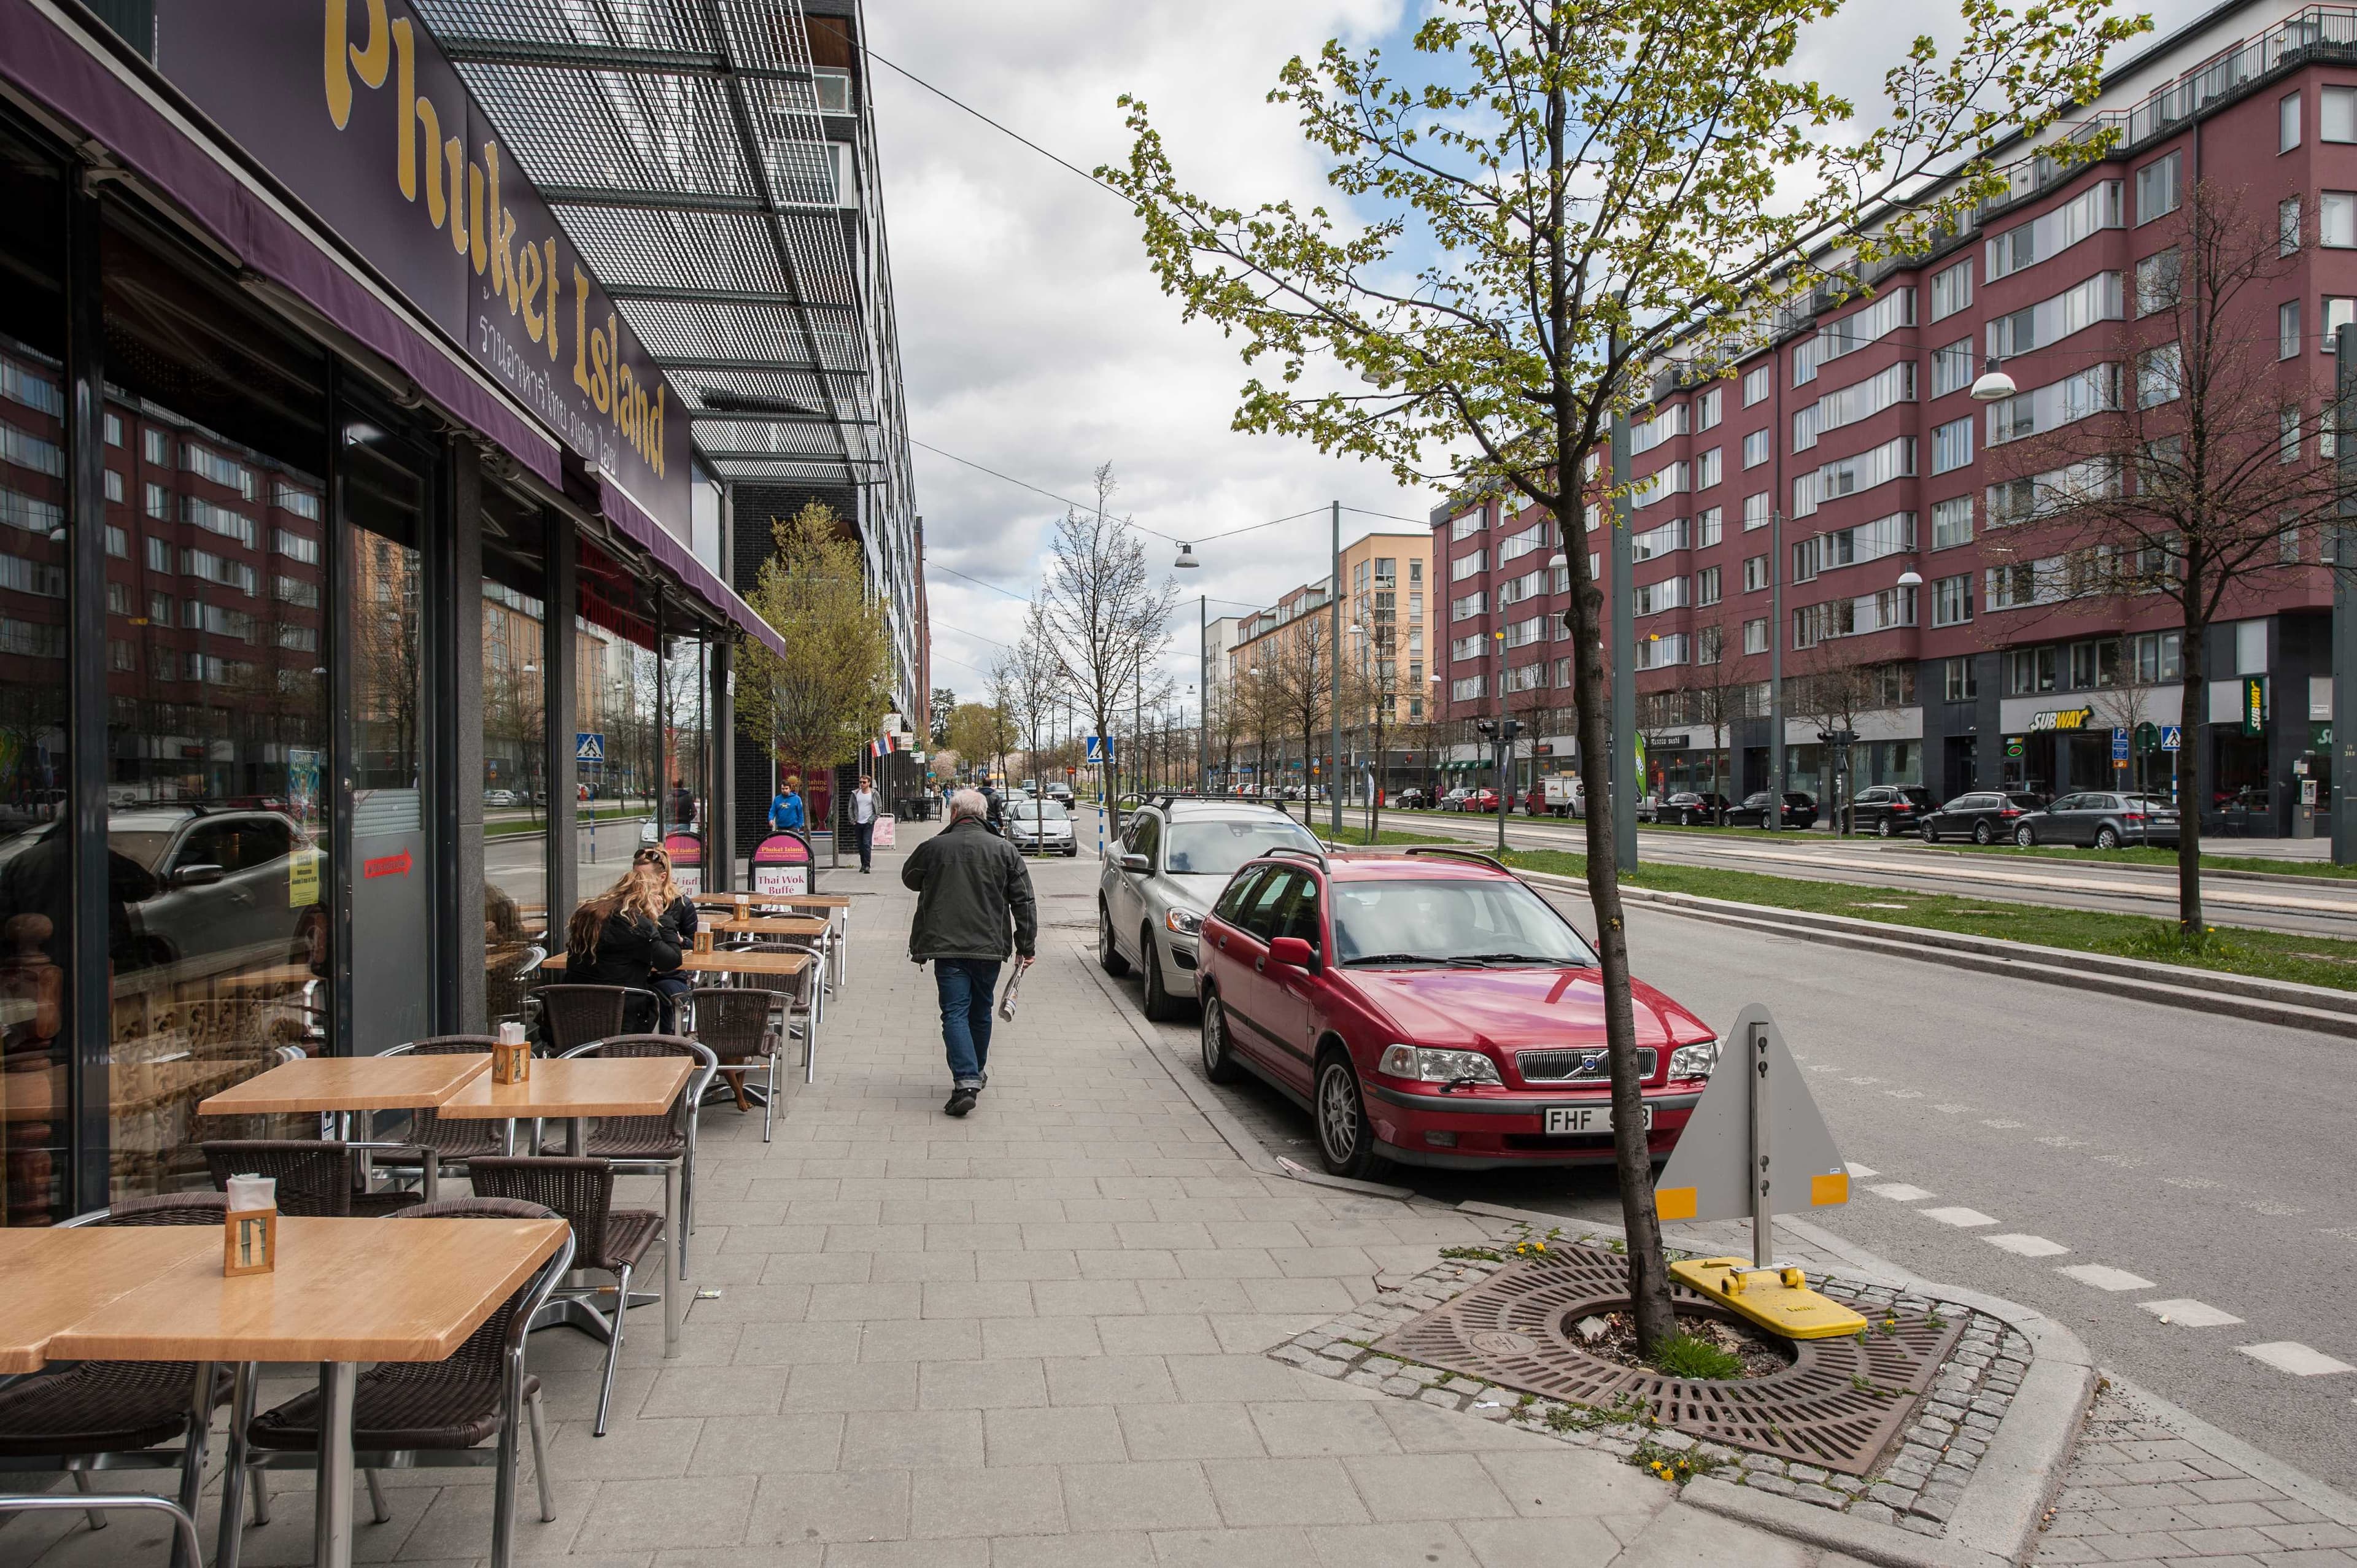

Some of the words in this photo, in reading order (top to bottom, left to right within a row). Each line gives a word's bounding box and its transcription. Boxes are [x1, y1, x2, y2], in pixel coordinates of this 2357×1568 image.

[324, 0, 560, 362] Phuket
[573, 262, 665, 481] Island
[2250, 681, 2262, 731] SUBWAY
[2030, 709, 2089, 732] SUBWAY
[757, 875, 780, 885] Thai
[782, 875, 805, 884] Wok
[768, 885, 794, 894] Buffé
[1550, 1110, 1592, 1131] FHF
